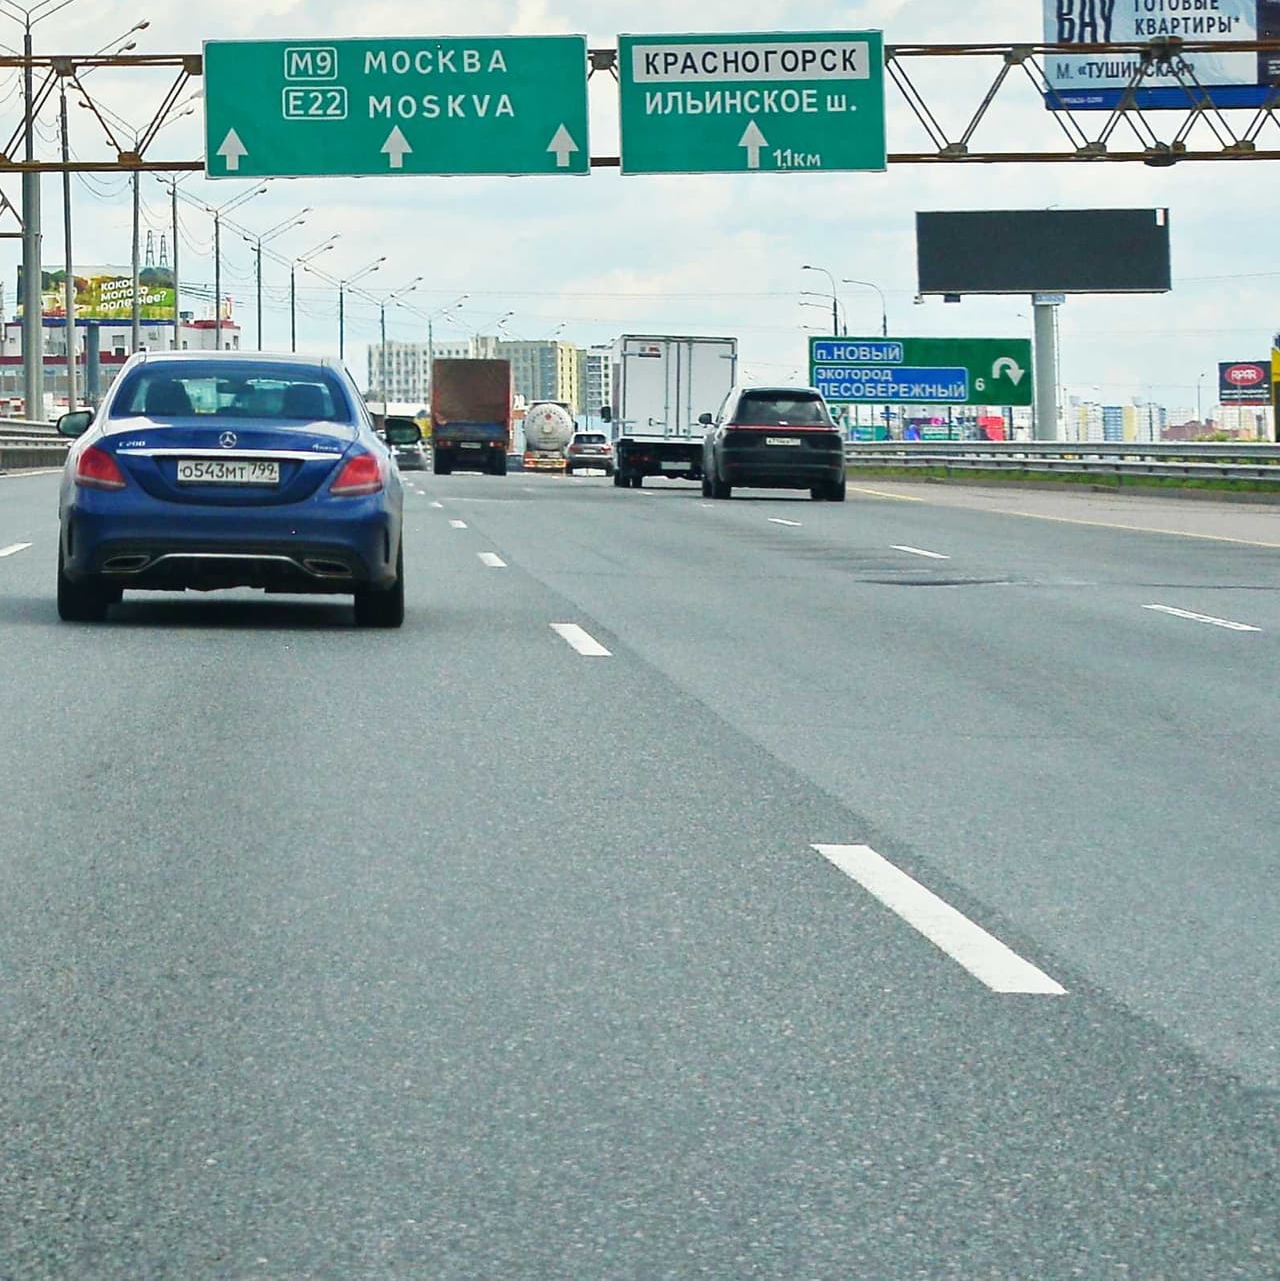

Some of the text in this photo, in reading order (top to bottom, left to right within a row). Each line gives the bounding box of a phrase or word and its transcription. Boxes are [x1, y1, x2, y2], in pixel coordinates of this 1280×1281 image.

[289, 50, 508, 75] М9 МОСКВА
[645, 49, 857, 74] КРАСНОГОРСК
[1056, 62, 1074, 79] М.
[288, 92, 515, 118] E22 MOSKVA
[645, 89, 857, 114] ИЛЬИНСКОЕ ш.
[101, 286, 148, 302] молоо
[817, 370, 893, 383] экогород
[975, 378, 985, 391] 6
[182, 463, 274, 479] О543МТ 799
